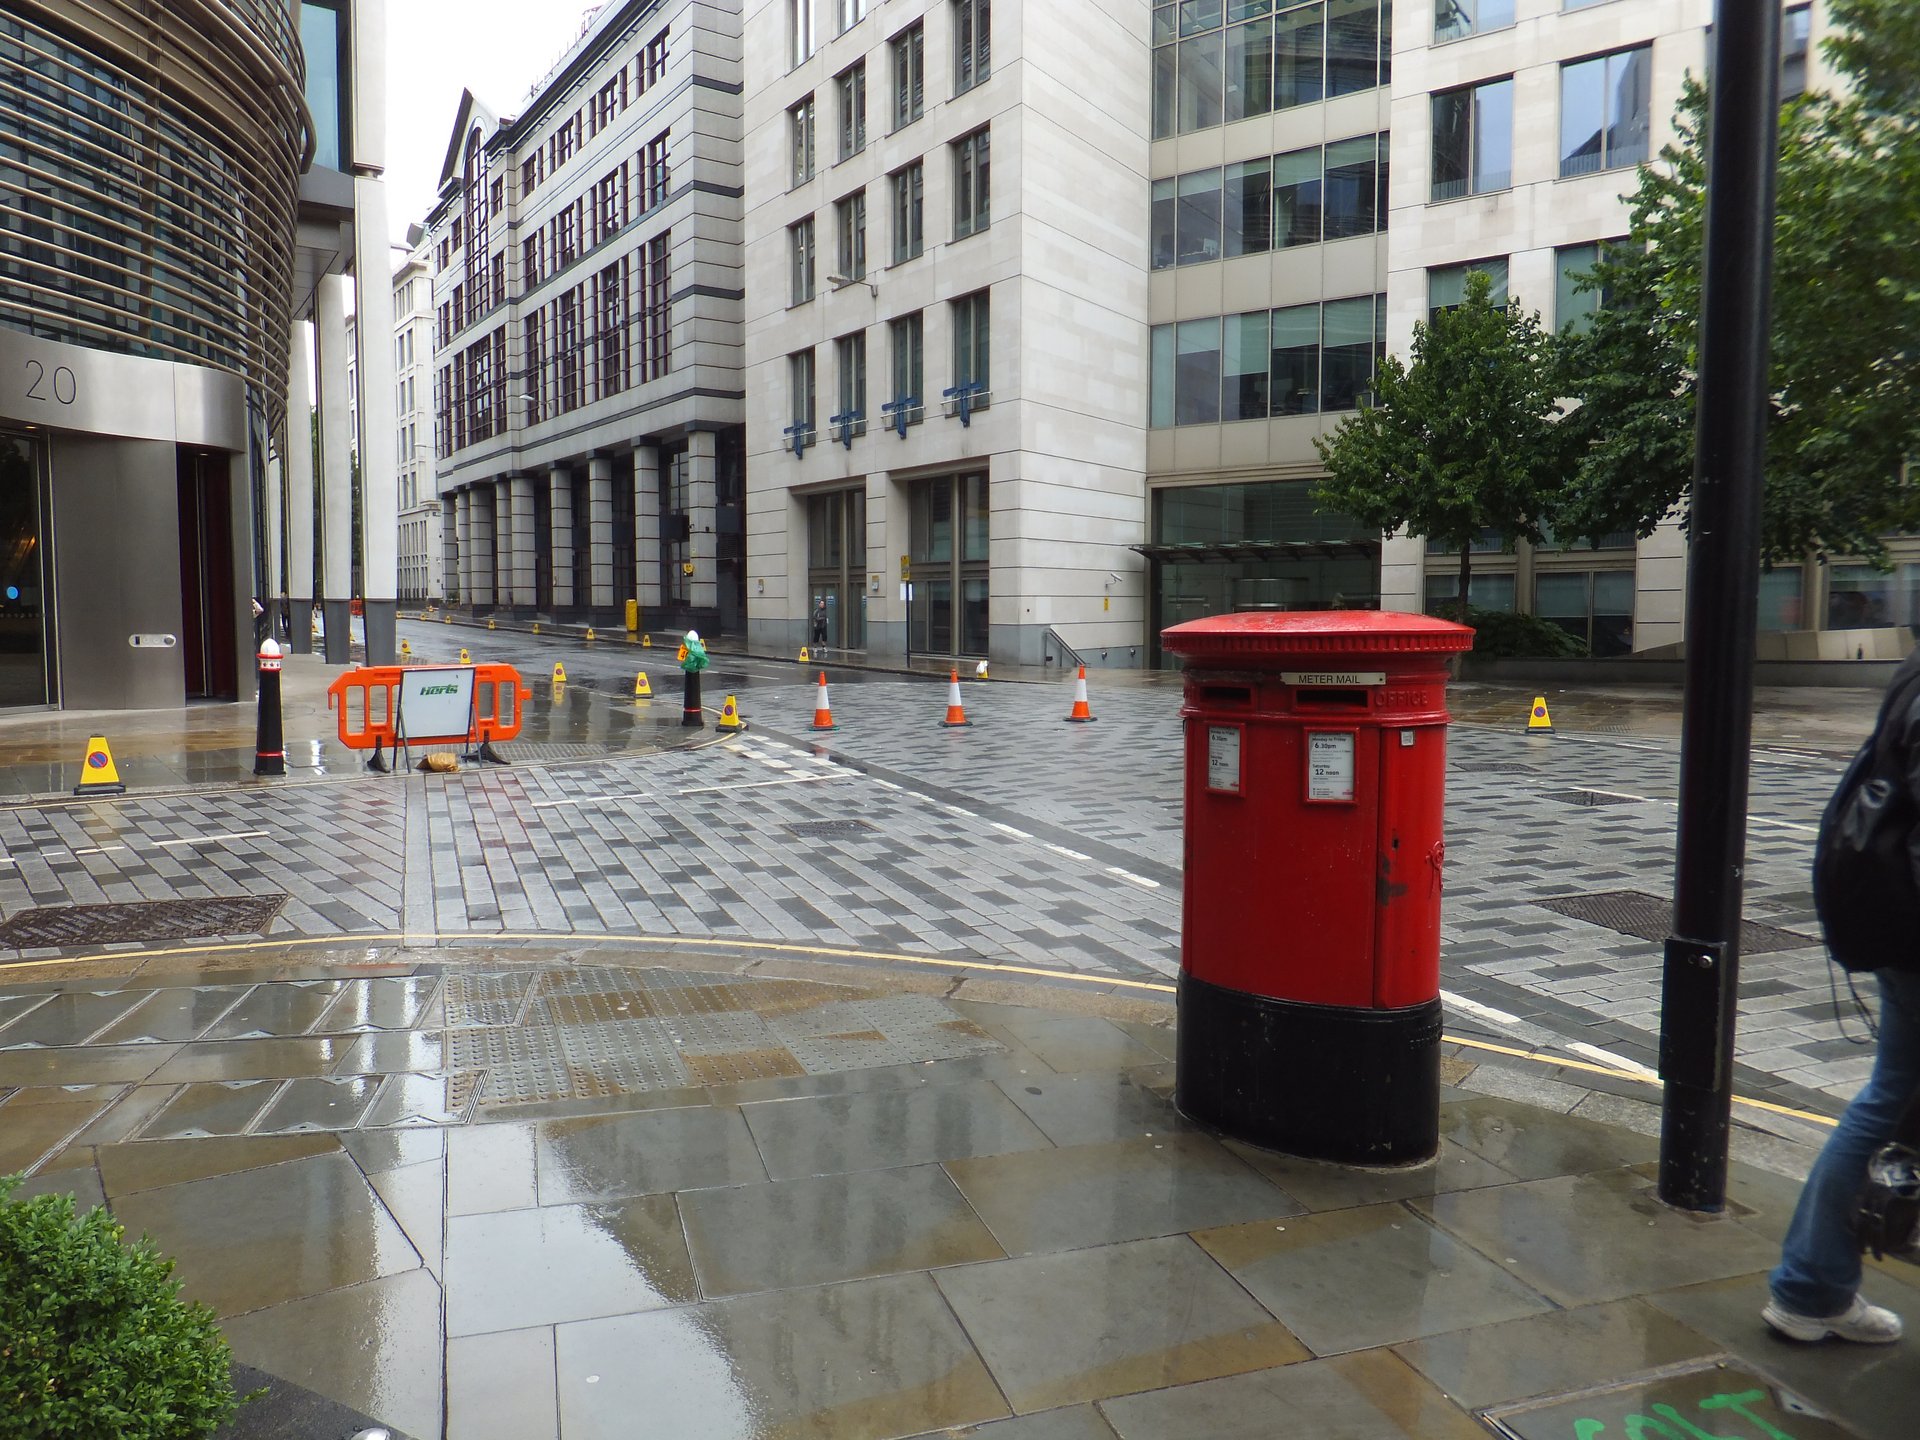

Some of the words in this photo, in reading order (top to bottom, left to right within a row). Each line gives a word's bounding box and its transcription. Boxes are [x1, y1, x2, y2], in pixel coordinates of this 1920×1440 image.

[25, 359, 77, 405] 20
[1298, 674, 1333, 683] METER
[1336, 674, 1360, 683] MAIL
[1374, 690, 1428, 706] OFFICE
[1315, 768, 1325, 776] 12
